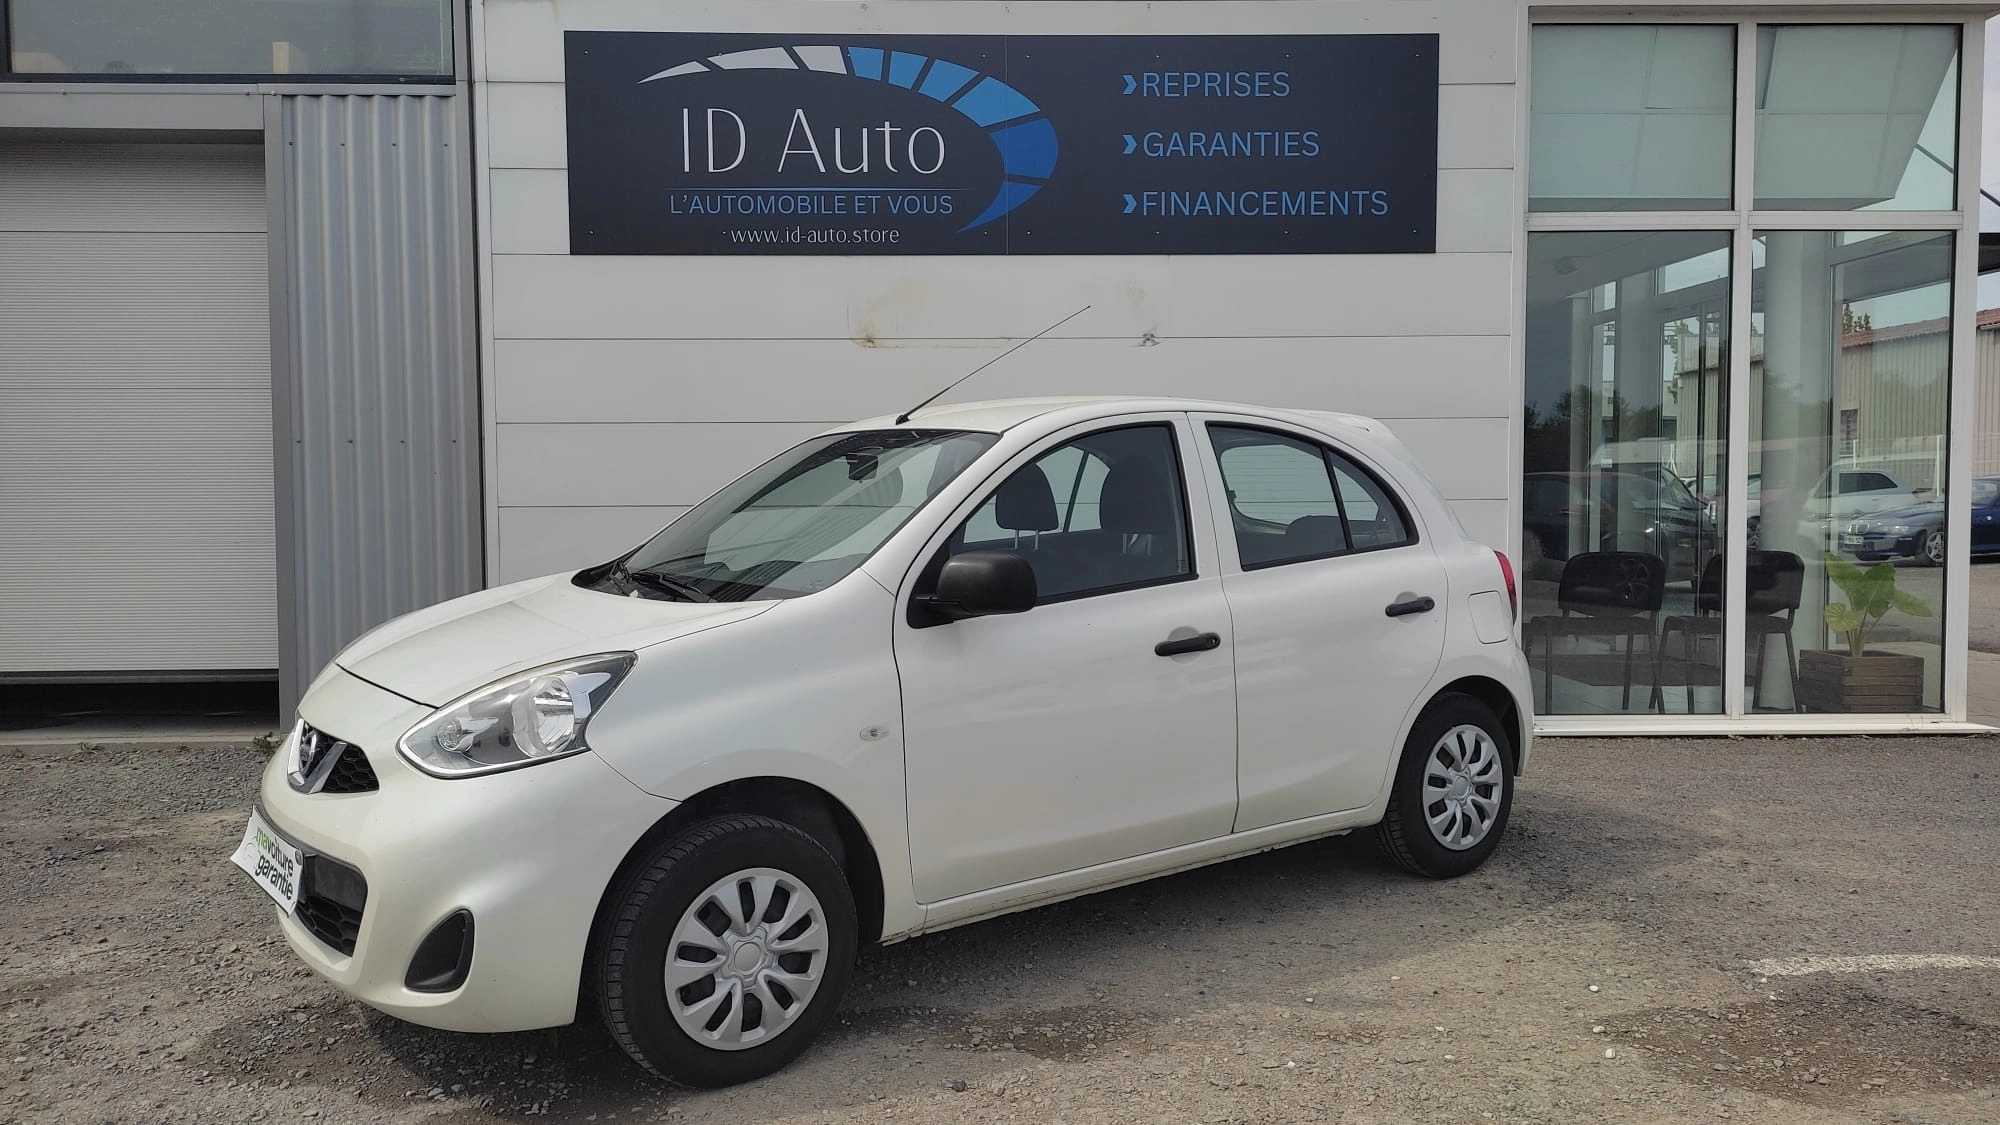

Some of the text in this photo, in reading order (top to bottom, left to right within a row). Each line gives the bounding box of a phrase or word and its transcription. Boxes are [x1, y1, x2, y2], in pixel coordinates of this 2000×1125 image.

[1142, 71, 1291, 97] REPRISES
[681, 106, 946, 174] ID Auto
[1143, 130, 1321, 157] GARANTIES
[669, 194, 954, 215] L'AUTOMOBILE ET VOUS
[1142, 190, 1390, 217] FINANCEMENTS
[730, 227, 900, 244] www.id-auto.store
[255, 854, 294, 901] garantie
